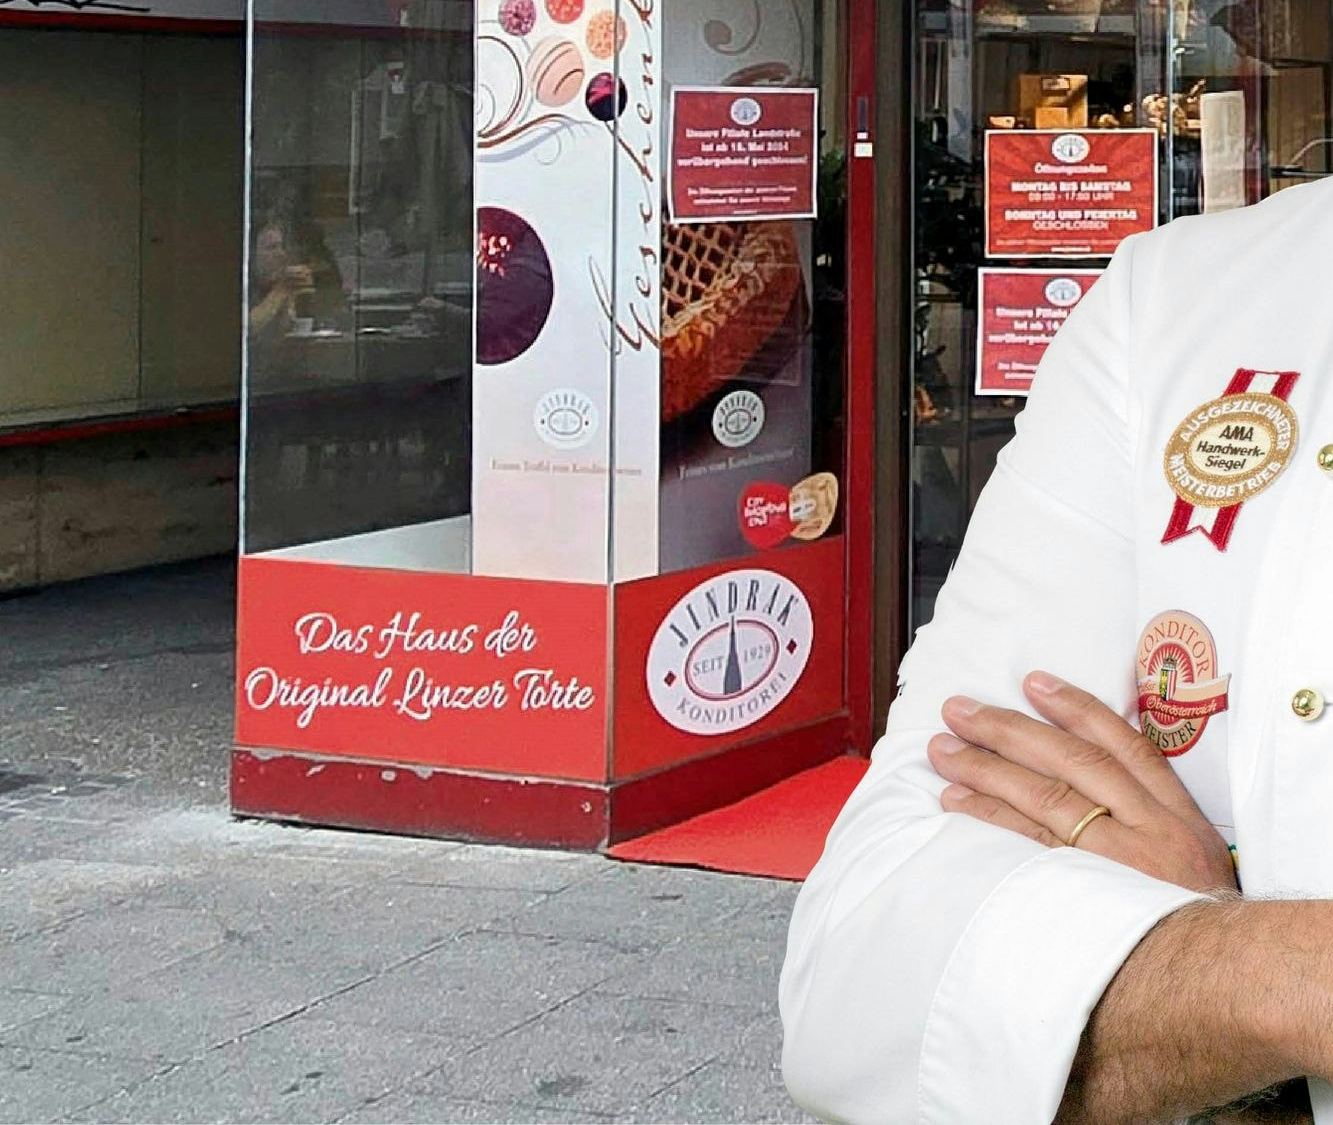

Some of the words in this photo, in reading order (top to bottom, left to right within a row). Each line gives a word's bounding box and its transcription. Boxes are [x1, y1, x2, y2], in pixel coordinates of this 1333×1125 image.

[1196, 440, 1265, 457] Handwerk-
[1219, 425, 1254, 441] AMA
[1169, 452, 1282, 498] MEISTERBETRIEB
[1205, 455, 1246, 471] Siegel
[295, 612, 369, 655] Das
[376, 612, 478, 658] Haus
[483, 610, 537, 653] der
[674, 577, 801, 649] JINDRAK
[692, 654, 724, 677] SEIT
[743, 643, 772, 665] 1929
[1139, 621, 1209, 676] KONDITOR
[245, 666, 384, 727] Original
[394, 667, 507, 720] Linzer
[513, 668, 595, 712] Torte
[674, 670, 788, 725] KONDITOREI
